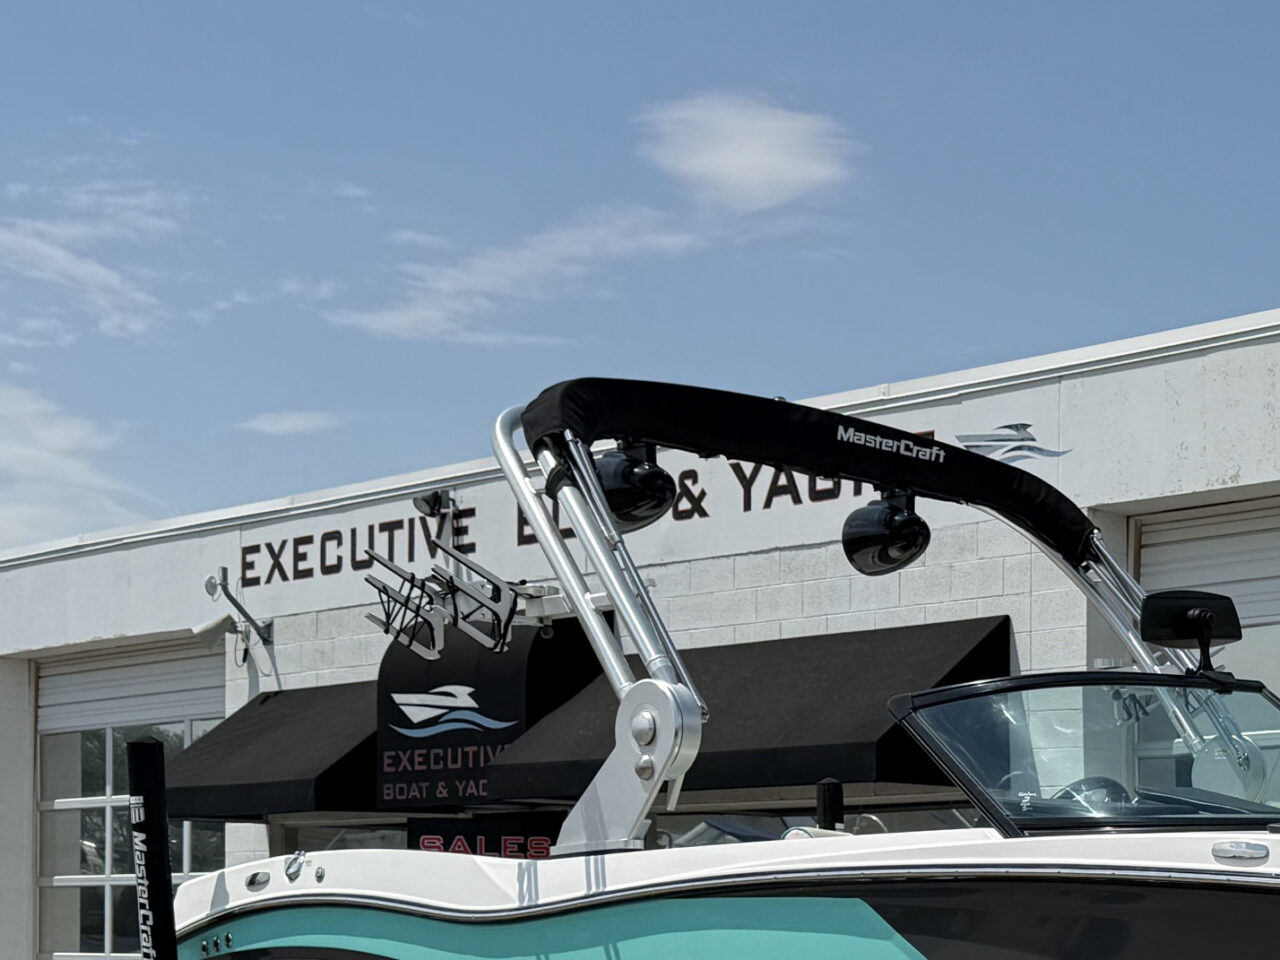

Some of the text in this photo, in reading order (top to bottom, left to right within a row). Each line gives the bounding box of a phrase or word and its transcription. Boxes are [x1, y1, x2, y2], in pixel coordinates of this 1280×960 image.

[837, 425, 946, 463] MasterCraft
[241, 507, 476, 589] EXECUTIVE
[672, 469, 710, 521] &
[383, 744, 508, 773] EXECUTIV
[383, 779, 489, 800] BOAT & YAC
[419, 835, 552, 860] SALES
